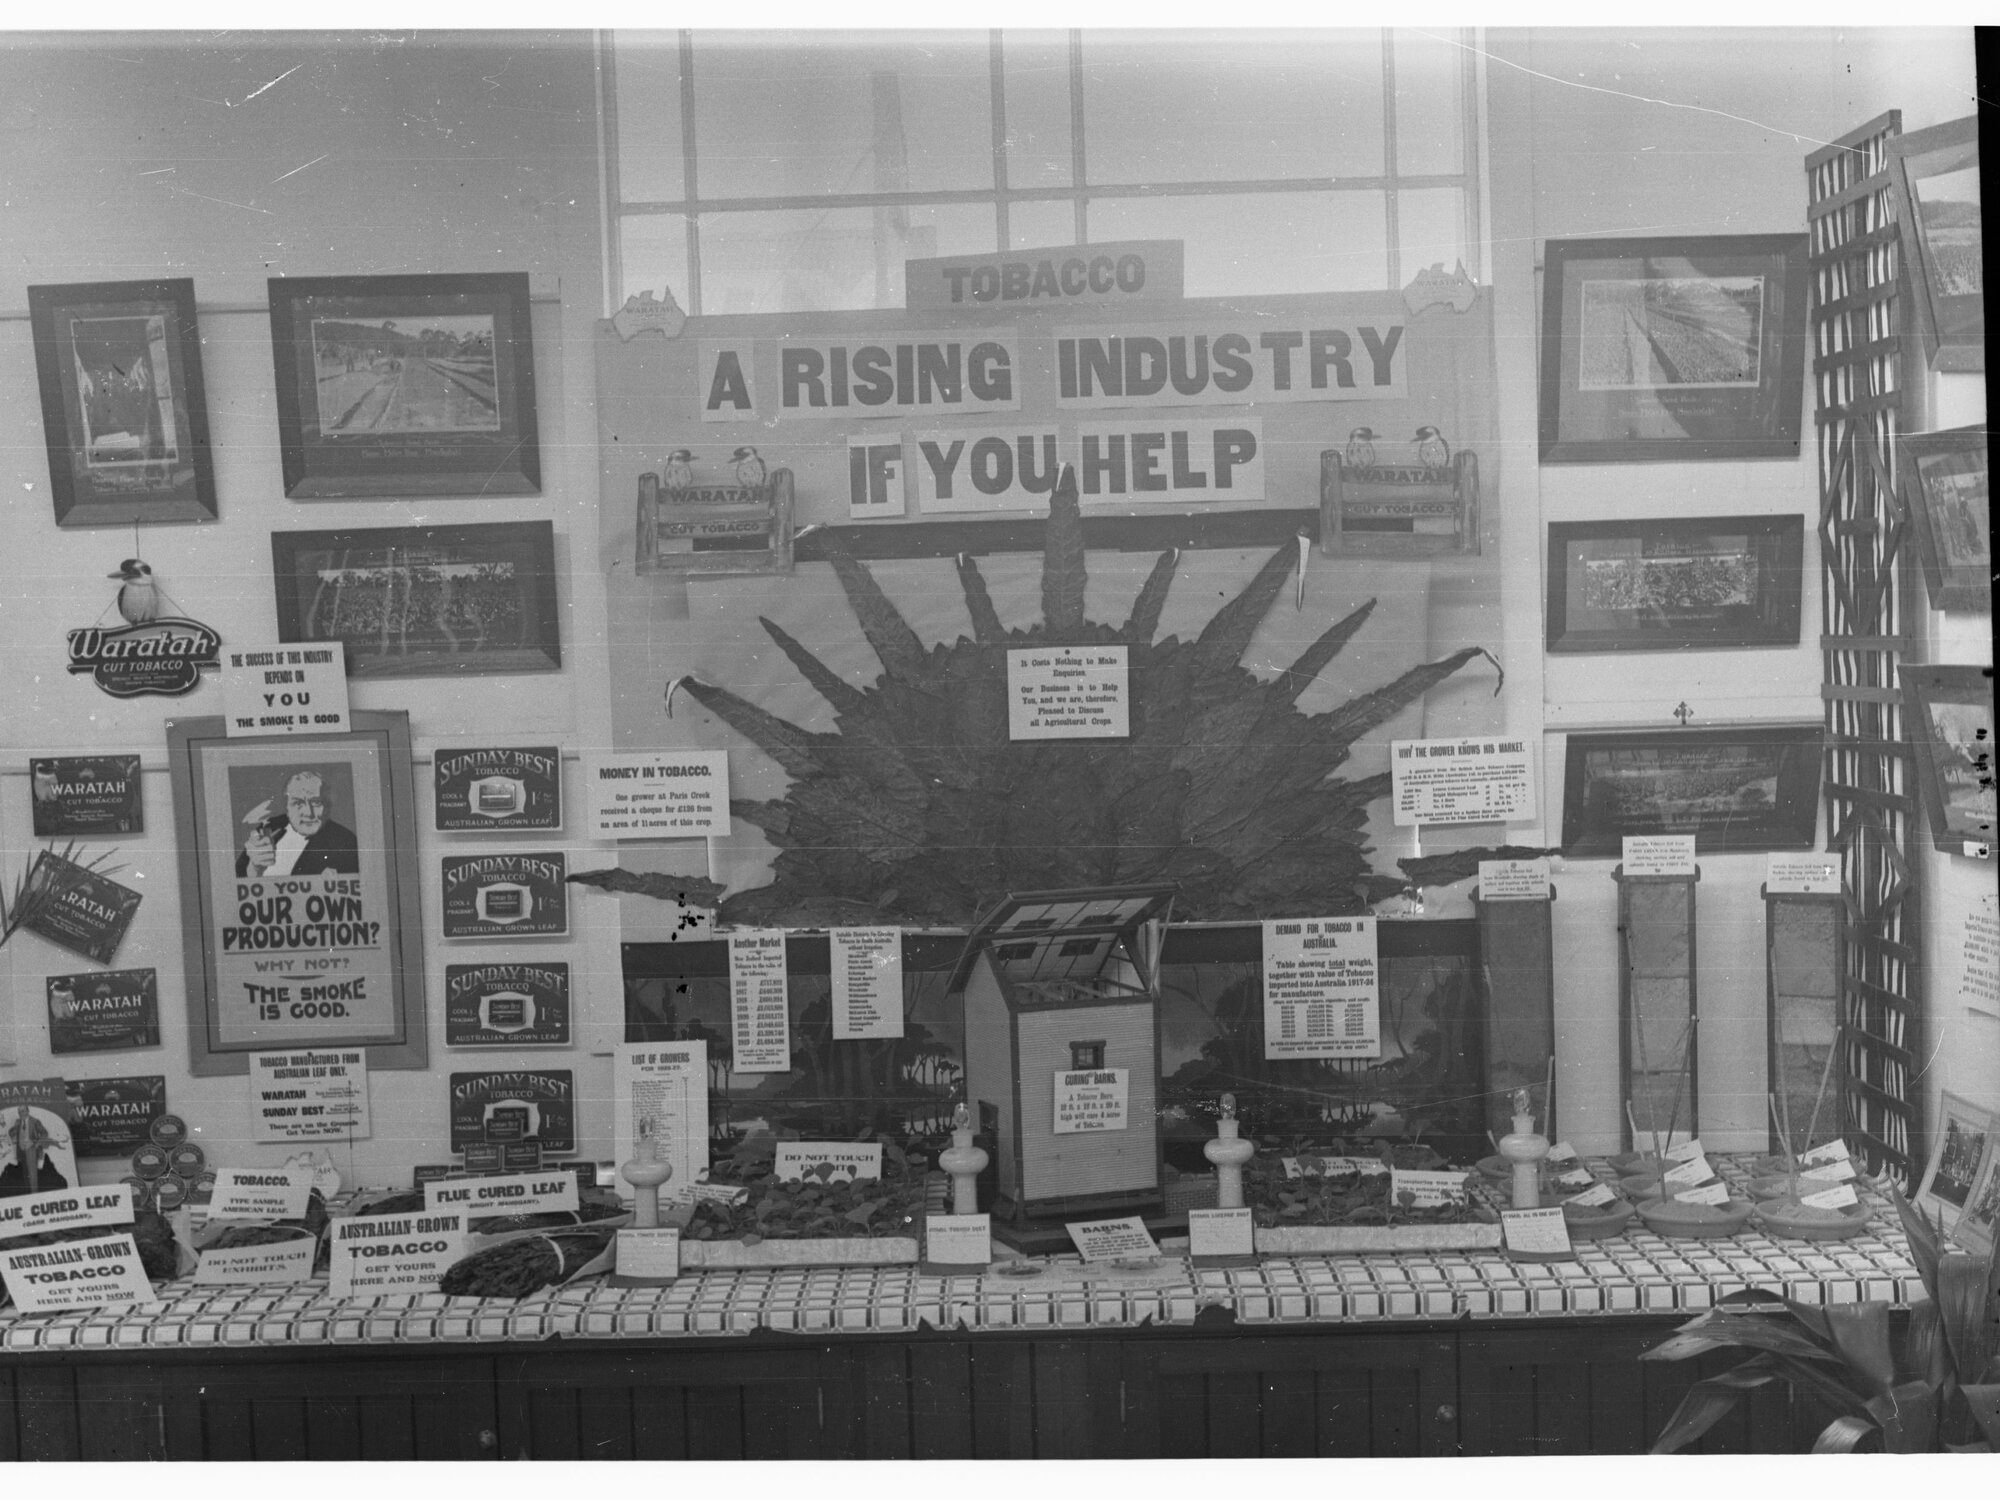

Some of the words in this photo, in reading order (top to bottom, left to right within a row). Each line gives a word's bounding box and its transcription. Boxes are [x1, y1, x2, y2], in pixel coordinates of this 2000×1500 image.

[942, 253, 1146, 303] TOBACCO
[706, 350, 753, 410] A
[782, 341, 1014, 408] RISING
[1058, 326, 1405, 399] INDUSTRY
[849, 444, 903, 504] IF
[918, 434, 1060, 500] YOU
[1081, 428, 1258, 495] HELP
[671, 489, 765, 502] WARATAH
[1354, 504, 1381, 514] CUT
[1386, 503, 1446, 514] TOBACCO
[670, 524, 697, 534] CUT
[701, 522, 761, 534] TOBACCO
[69, 628, 210, 660] Waratah
[231, 654, 244, 668] THE
[245, 652, 275, 667] SUCCESS
[276, 651, 285, 665] OF
[286, 651, 301, 665] THIS
[302, 650, 333, 664] INDUSTRY
[1054, 657, 1083, 667] Nothing
[1086, 657, 1094, 665] to
[1097, 656, 1118, 665] Make
[102, 661, 126, 673] CUT
[128, 660, 184, 672] TOBACCO
[264, 670, 293, 685] DEPENDS
[295, 669, 305, 683] ON
[1020, 686, 1034, 694] Our
[1077, 684, 1084, 692] is
[1089, 683, 1097, 692] to
[1102, 683, 1119, 692] Help
[1040, 695, 1054, 704] and
[1067, 706, 1076, 714] to
[1078, 706, 1105, 715] Discuss
[235, 717, 255, 729] THE
[259, 715, 294, 727] SMOKE
[299, 714, 310, 725] IS
[314, 713, 341, 724] GOOD
[1030, 718, 1040, 727] all
[1044, 717, 1087, 727] Agricultural
[1398, 747, 1413, 759] WHY
[1415, 746, 1428, 758] THE
[1429, 745, 1456, 757] GROWER
[1457, 744, 1481, 756] KNOWS
[1483, 743, 1496, 755] HIS
[475, 767, 520, 776] TOBACCO
[599, 766, 639, 780] MONEY
[642, 766, 655, 779] IN
[657, 765, 712, 778] TOBACCO.
[444, 819, 495, 828] AUSTRALIAN
[498, 818, 529, 827] GROWN
[482, 872, 526, 882] TOBACCO
[237, 882, 265, 902] DO
[274, 881, 313, 895] YOU
[323, 880, 362, 897] USE
[239, 896, 294, 925] OUR
[305, 895, 363, 923] OWN
[222, 921, 381, 950] PRODUCTION?
[452, 926, 503, 935] AUSTRALIAN
[505, 923, 536, 932] GROWN
[538, 922, 558, 931] LEAF
[1275, 924, 1302, 936] DEMAND
[1307, 923, 1320, 935] FOR
[1324, 921, 1353, 934] TOBACCO
[1356, 921, 1365, 933] IN
[254, 959, 296, 973] WHY
[304, 958, 351, 971] NOT?
[1275, 960, 1297, 970] Table
[1298, 959, 1327, 970] showing
[1328, 958, 1346, 968] total
[1269, 971, 1298, 982] together
[1299, 970, 1315, 979] with
[1317, 969, 1336, 978] value
[1338, 968, 1347, 977] of
[1347, 968, 1374, 977] Tobacco
[243, 981, 292, 1005] THE
[300, 976, 368, 1002] SMOKE
[486, 982, 530, 992] TOBACCO
[1269, 980, 1299, 991] imported
[1300, 979, 1314, 988] into
[1315, 978, 1347, 988] Australia
[1269, 989, 1280, 999] for
[259, 1004, 282, 1021] IS
[289, 1001, 351, 1020] GOOD.
[259, 1056, 289, 1068] TOBACCO
[290, 1054, 340, 1066] MANUFACTURED
[342, 1053, 361, 1065] FROM
[632, 1054, 646, 1066] LIST
[648, 1053, 657, 1065] OF
[659, 1051, 691, 1064] GROWERS
[273, 1067, 311, 1080] AUSTRALIAN
[312, 1066, 328, 1078] LEAF
[1065, 1073, 1090, 1087] CURING
[261, 1089, 307, 1102] WARATAH
[490, 1090, 534, 1099] TOBACCO
[262, 1107, 299, 1118] SUNDAY
[301, 1105, 325, 1117] BEST
[785, 1154, 802, 1162] DO
[805, 1154, 829, 1162] NOT
[834, 1154, 875, 1162] TOUCH
[232, 1175, 291, 1187] TOBACCO.
[437, 1188, 472, 1203] FLUE
[478, 1184, 526, 1199] CURED
[532, 1181, 567, 1196] LEAF
[0, 1206, 24, 1222] LUE
[30, 1198, 80, 1217] CURED
[86, 1194, 122, 1210] LEAF
[339, 1215, 461, 1241] AUSTRALIAN-GROWN
[9, 1241, 133, 1271] AUSTRALIAN-GROWN
[348, 1240, 449, 1260] TOBACCO
[24, 1264, 126, 1285] TOBACCO
[365, 1264, 391, 1274] GET
[394, 1262, 437, 1273] YOURS
[350, 1277, 385, 1287] HERE
[388, 1275, 416, 1284] AND
[48, 1287, 75, 1297] GET
[77, 1283, 121, 1294] YOURS
[36, 1296, 72, 1306] HERE
[76, 1294, 104, 1304] AND
[106, 1291, 136, 1301] NOW
